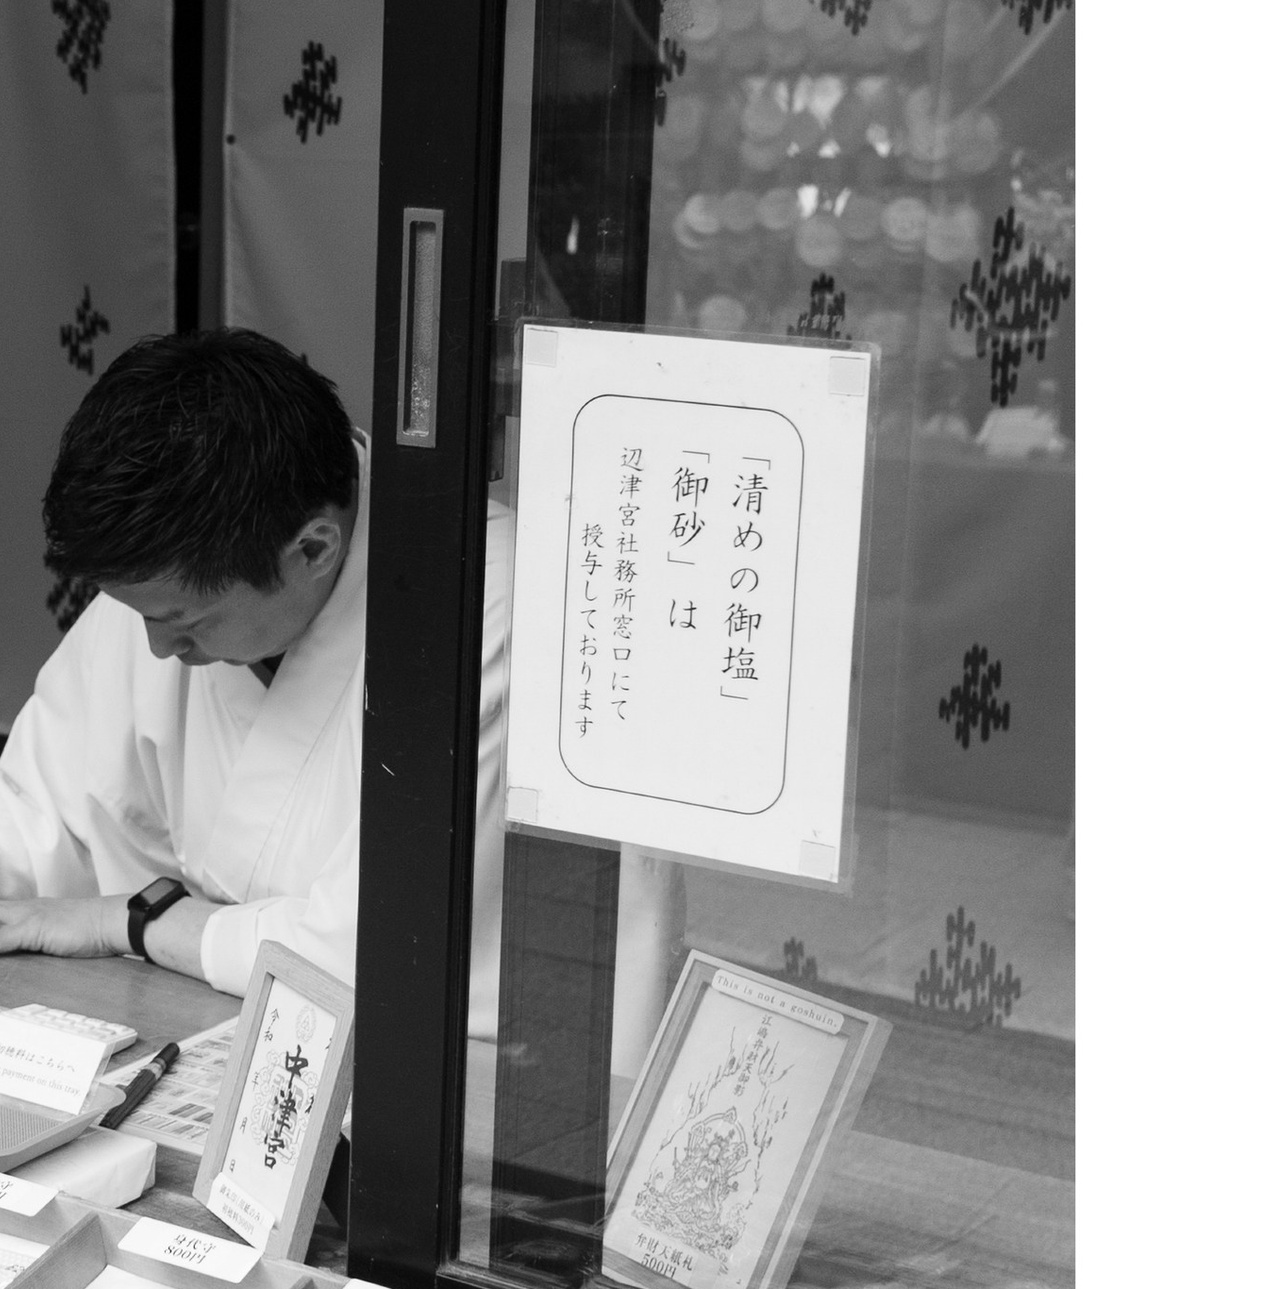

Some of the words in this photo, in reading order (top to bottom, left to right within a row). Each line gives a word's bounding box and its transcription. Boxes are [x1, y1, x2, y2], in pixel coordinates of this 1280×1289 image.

[574, 523, 605, 738] 授与しております
[610, 446, 644, 721] 辺津宮社務所窓口にて
[720, 455, 771, 700] 「清めの御塩」
[716, 975, 739, 992] This
[743, 983, 753, 996] is
[757, 991, 775, 1005] not
[790, 1002, 838, 1028] goshuin.
[1, 1067, 35, 1083] payment
[37, 1077, 47, 1085] on
[48, 1078, 63, 1090] this
[64, 1084, 81, 1098] tray.
[164, 1244, 206, 1264] 800円
